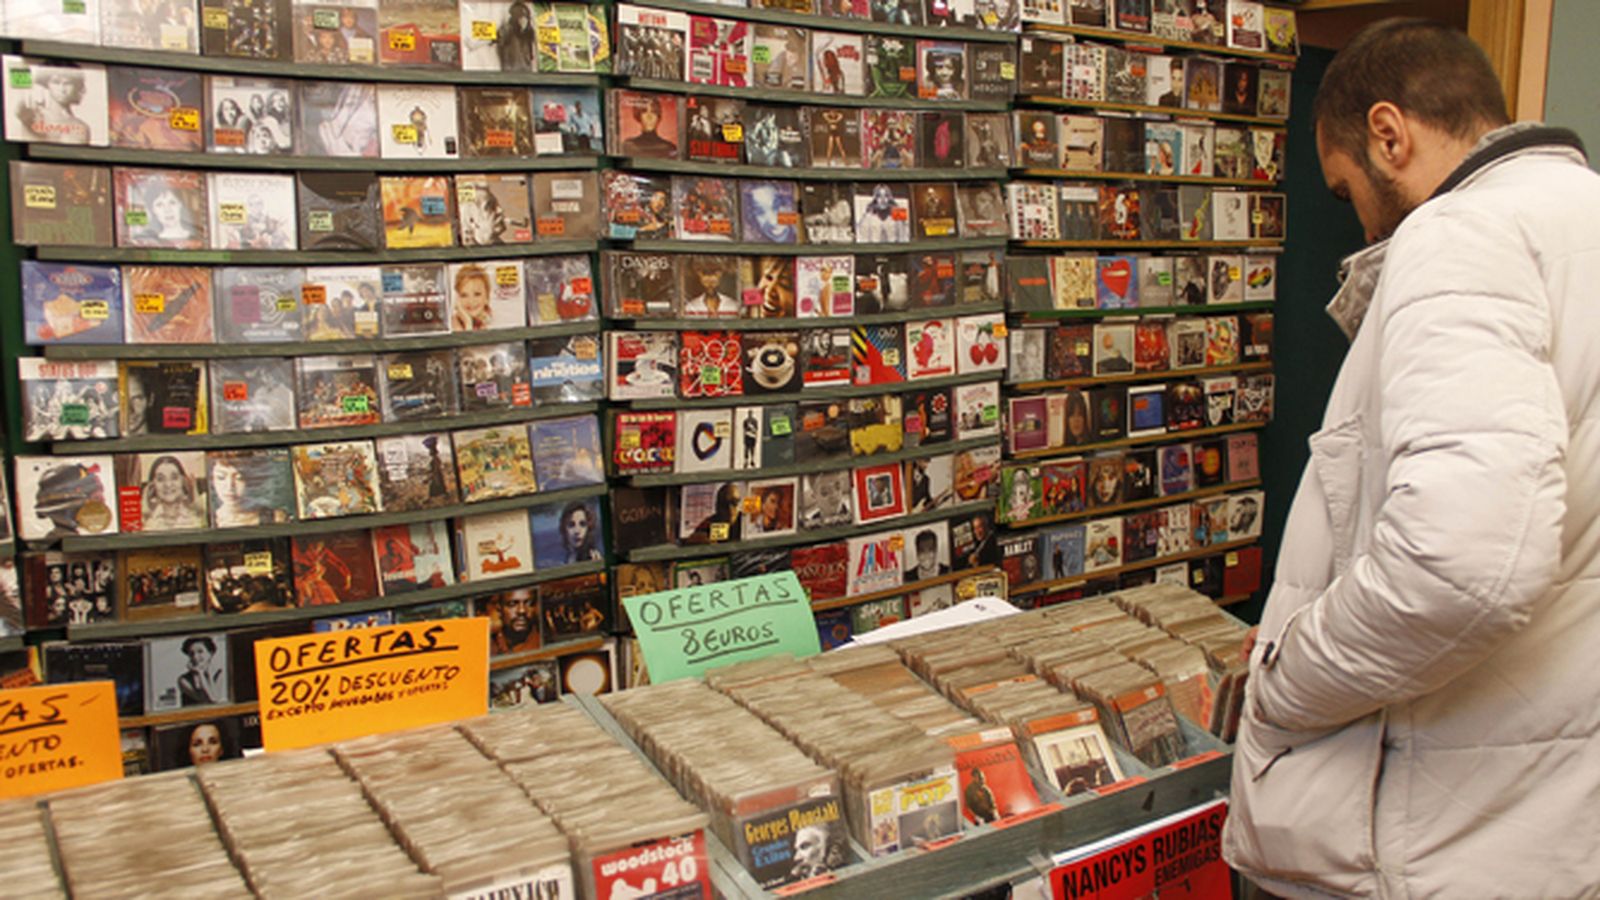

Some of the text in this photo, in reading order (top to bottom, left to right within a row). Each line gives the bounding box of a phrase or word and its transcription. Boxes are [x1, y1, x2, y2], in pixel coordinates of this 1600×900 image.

[639, 577, 791, 626] OFERTAS
[269, 625, 446, 672] OFERTAS
[270, 665, 461, 705] 20% DESCUENTO
[0, 693, 69, 725] AS
[601, 839, 694, 877] woodstock
[661, 856, 698, 887] 40
[1062, 813, 1221, 900] NANCYS RUBIAS
[1154, 843, 1221, 888] ENEMIGAS
